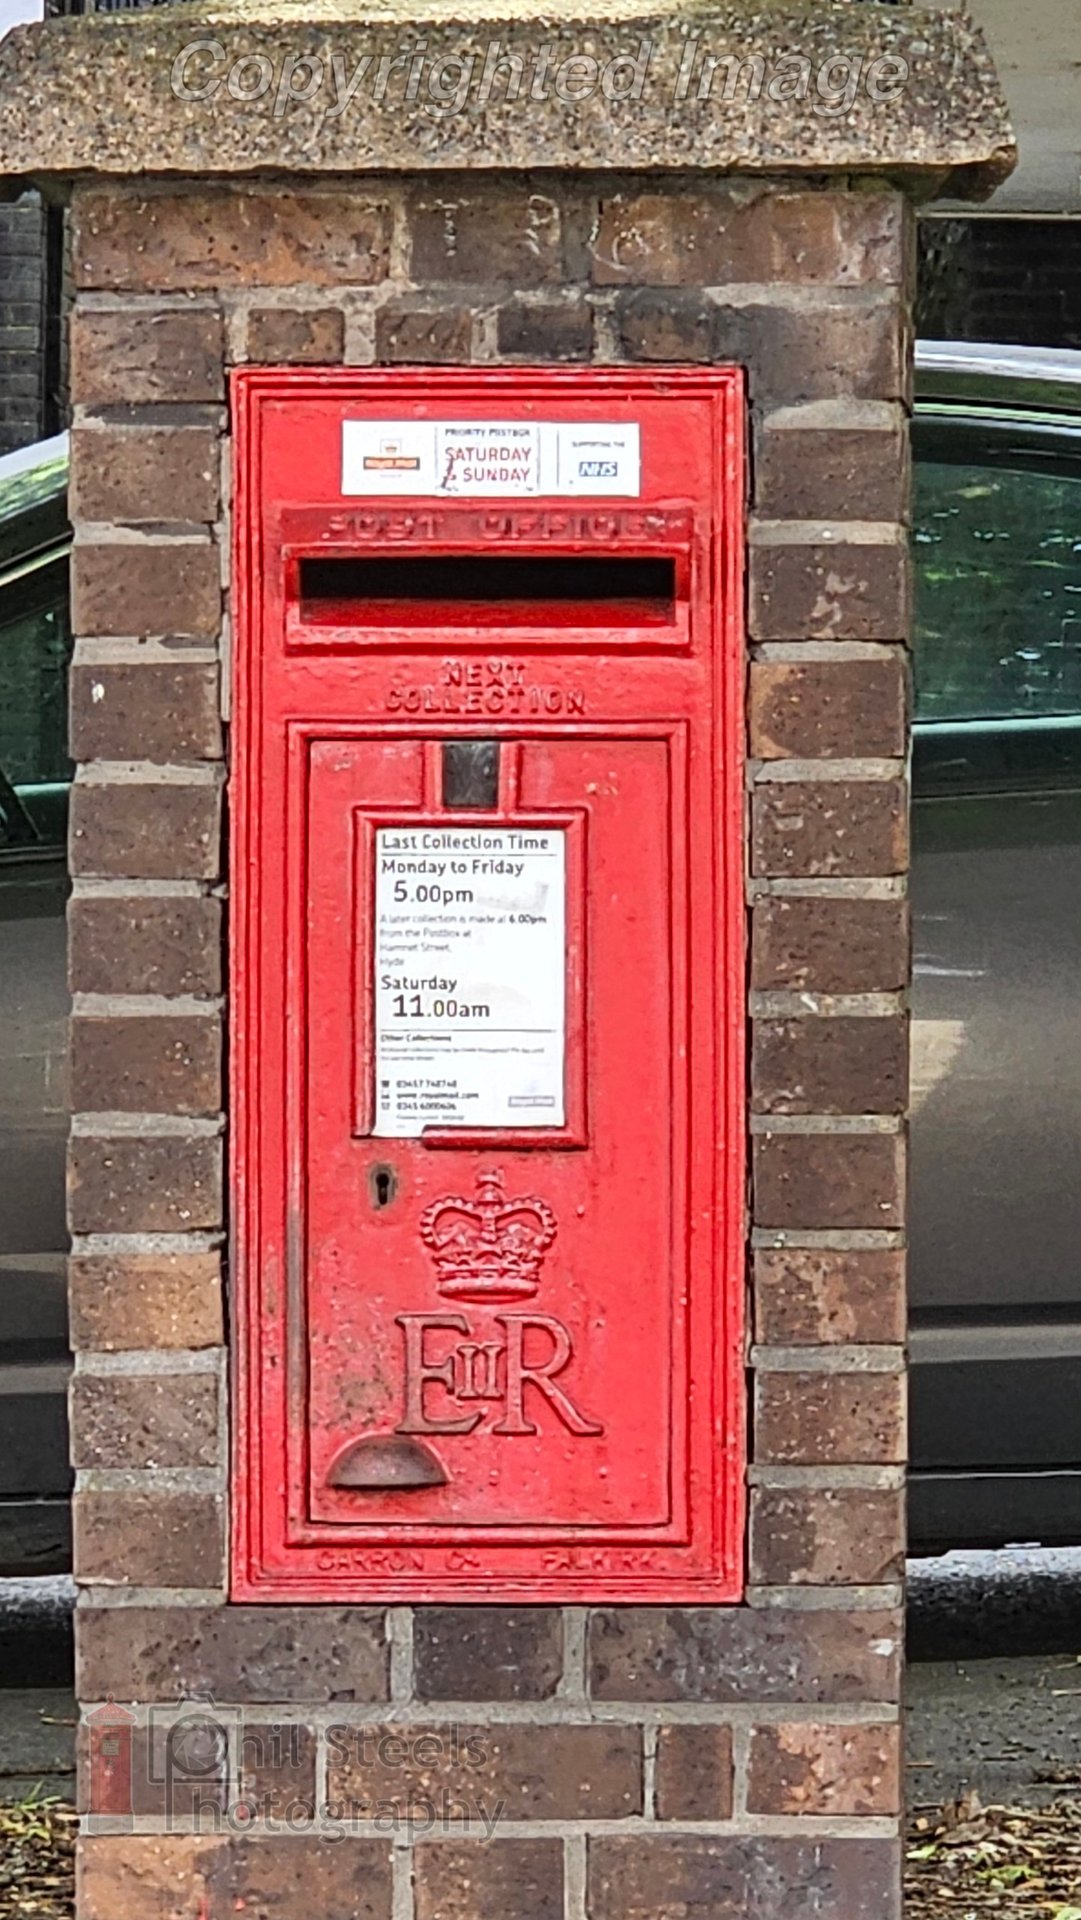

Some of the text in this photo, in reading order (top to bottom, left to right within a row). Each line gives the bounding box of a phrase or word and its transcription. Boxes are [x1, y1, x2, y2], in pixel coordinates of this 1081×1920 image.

[445, 447, 531, 462] SATURDAY
[463, 468, 530, 482] SUNDAY
[580, 462, 617, 476] NHS
[326, 512, 648, 540] POST OFFICE
[443, 660, 525, 687] NEXT
[386, 687, 586, 715] COLLECTION
[382, 834, 549, 850] Last Collection Time
[381, 859, 525, 877] Monday to Friday
[393, 880, 474, 907] 5.00pm
[381, 975, 458, 993] Saturday
[392, 994, 490, 1018] 11.00am
[317, 1551, 424, 1570] CARRON
